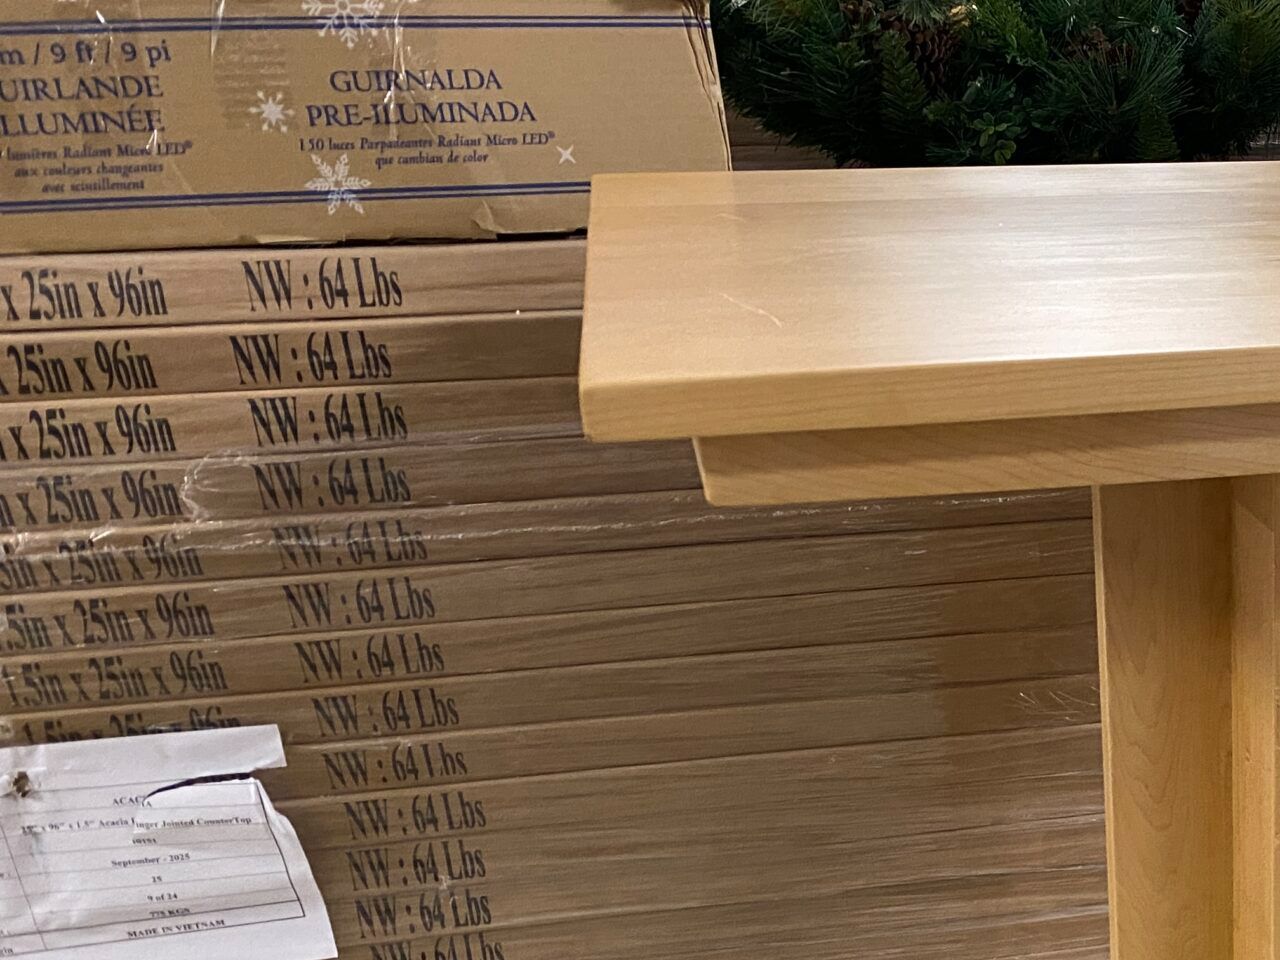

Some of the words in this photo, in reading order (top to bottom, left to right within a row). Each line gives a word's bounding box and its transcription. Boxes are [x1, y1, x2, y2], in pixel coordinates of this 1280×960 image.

[50, 42, 66, 61] 9
[121, 41, 137, 60] 9
[146, 38, 172, 69] pi
[329, 69, 503, 93] GUIRNALDA
[305, 101, 538, 128] PRE-ILUMINADA
[64, 142, 112, 159] Radiant
[328, 138, 356, 151] luces
[360, 135, 433, 152] Parpadeantes
[438, 133, 482, 148] Radiant
[486, 132, 518, 146] Micro
[375, 157, 395, 171] que
[397, 153, 444, 165] cambian
[447, 152, 460, 164] de
[463, 151, 490, 163] color
[43, 163, 93, 177] couleurs
[96, 161, 164, 180] changeantes
[1, 285, 20, 321] x
[21, 268, 83, 320] 25in
[87, 282, 106, 317] x
[107, 266, 168, 317] 96in
[319, 257, 349, 309] 64
[352, 257, 402, 307] Lbs
[6, 343, 72, 395] 25in
[74, 357, 95, 391] x
[94, 340, 159, 390] 96in
[307, 331, 338, 381] 64
[340, 330, 392, 379] Lbs
[9, 425, 30, 460] x
[29, 408, 92, 459] 25in
[95, 421, 116, 455] x
[115, 404, 177, 454] 96in
[324, 393, 355, 443] 64
[356, 392, 408, 441] Lbs
[36, 474, 100, 523] 25in
[121, 469, 183, 518] 96in
[328, 458, 360, 506] 64
[361, 457, 411, 503] Lbs
[58, 539, 122, 584] 25in
[143, 533, 204, 578] 96in
[73, 598, 134, 645] 25in
[155, 591, 215, 638] 96in
[356, 578, 385, 623] 64
[387, 576, 436, 620] Lbs
[89, 656, 149, 700] 25in
[169, 650, 229, 694] 96in
[367, 634, 395, 677] 64
[397, 632, 445, 674] Lbs
[382, 690, 411, 731] 64
[412, 687, 460, 728] Lbs
[161, 819, 194, 829] Jointed
[412, 794, 439, 833] 64
[441, 791, 486, 830] Lbs
[111, 856, 160, 868] September
[169, 853, 190, 862] 2025
[412, 843, 439, 884] 64
[440, 840, 486, 880] Lbs
[128, 928, 158, 938] MADE
[176, 919, 226, 931] VIETNAM
[419, 892, 446, 932] 64
[450, 889, 492, 927] Lbs
